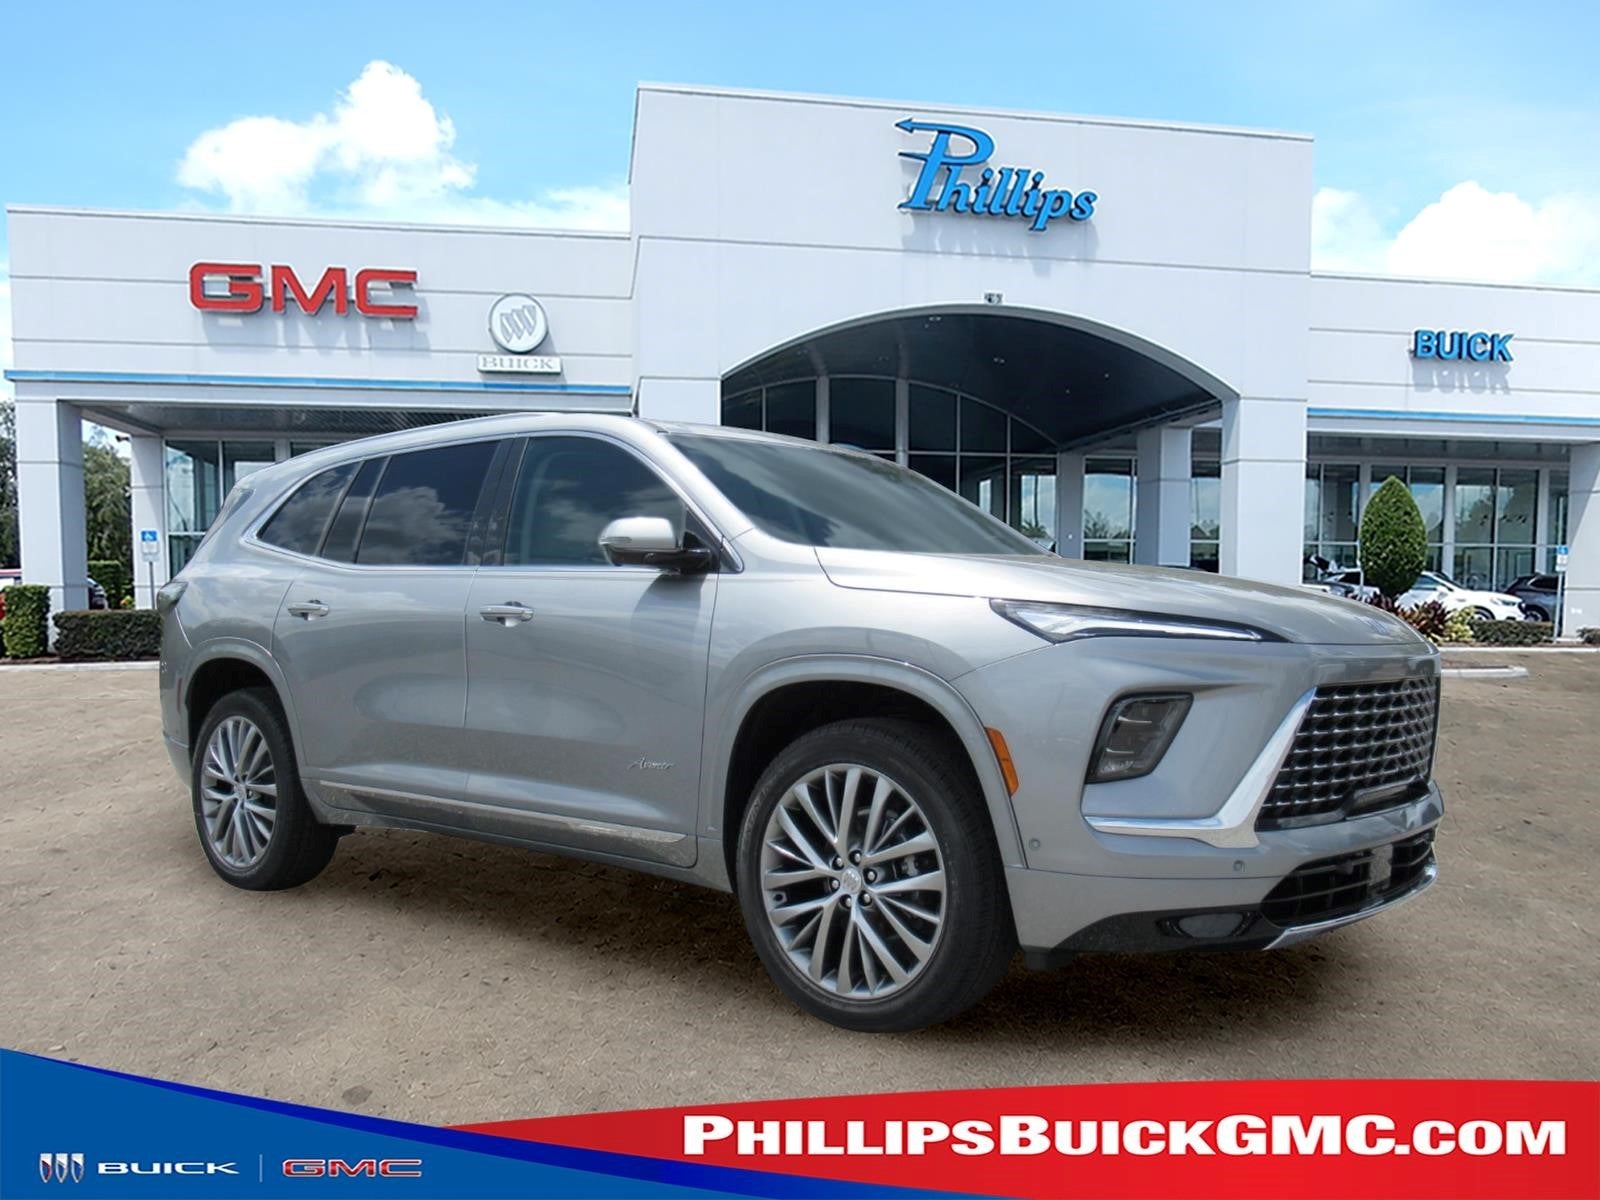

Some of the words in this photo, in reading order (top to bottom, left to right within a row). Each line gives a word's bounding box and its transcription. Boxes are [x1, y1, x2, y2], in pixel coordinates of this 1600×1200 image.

[895, 118, 1098, 231] Phillips
[189, 262, 418, 318] GMC
[481, 355, 555, 371] BUICK
[1414, 329, 1514, 361] BUICK
